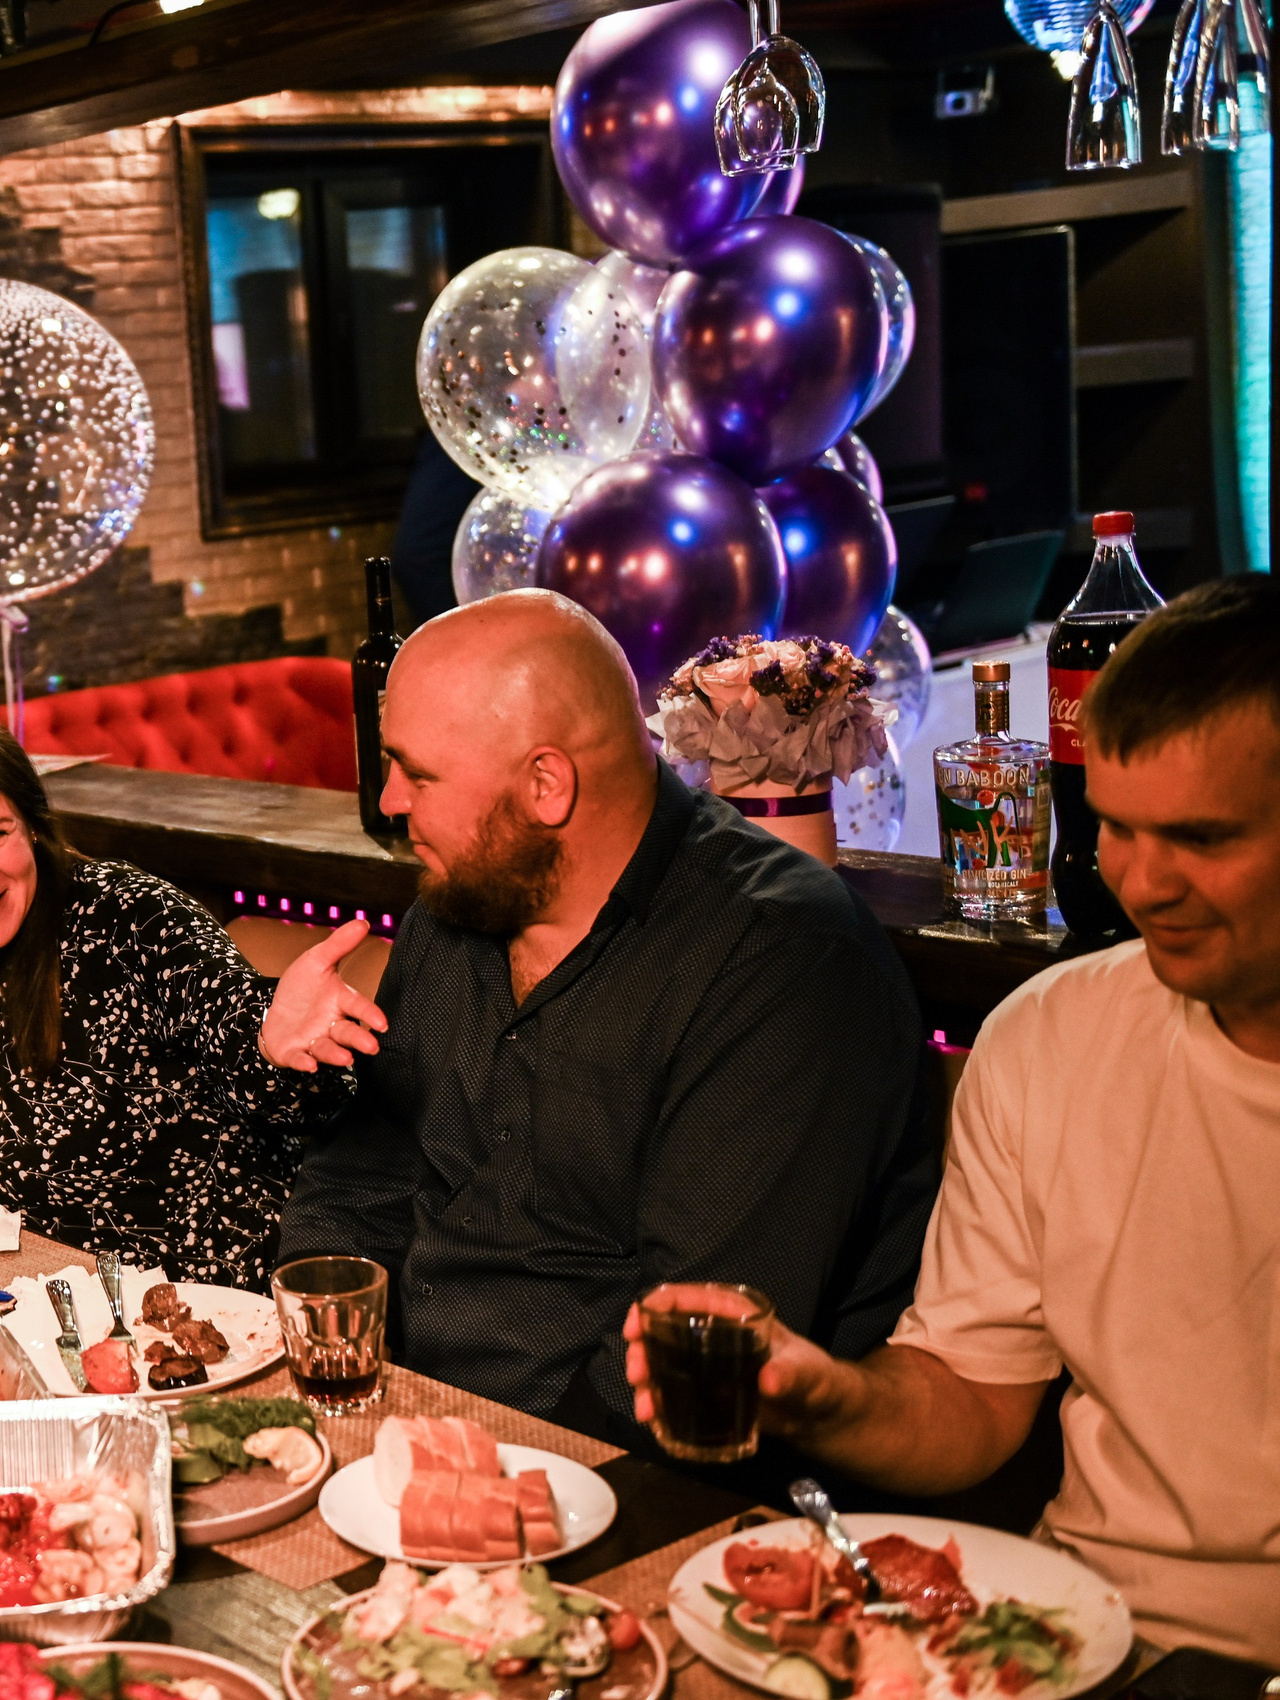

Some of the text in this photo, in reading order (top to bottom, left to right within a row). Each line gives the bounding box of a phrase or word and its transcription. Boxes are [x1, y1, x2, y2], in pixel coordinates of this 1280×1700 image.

[1049, 687, 1082, 721] Coca
[956, 767, 1029, 788] BABOON
[1011, 868, 1027, 880] GIN
